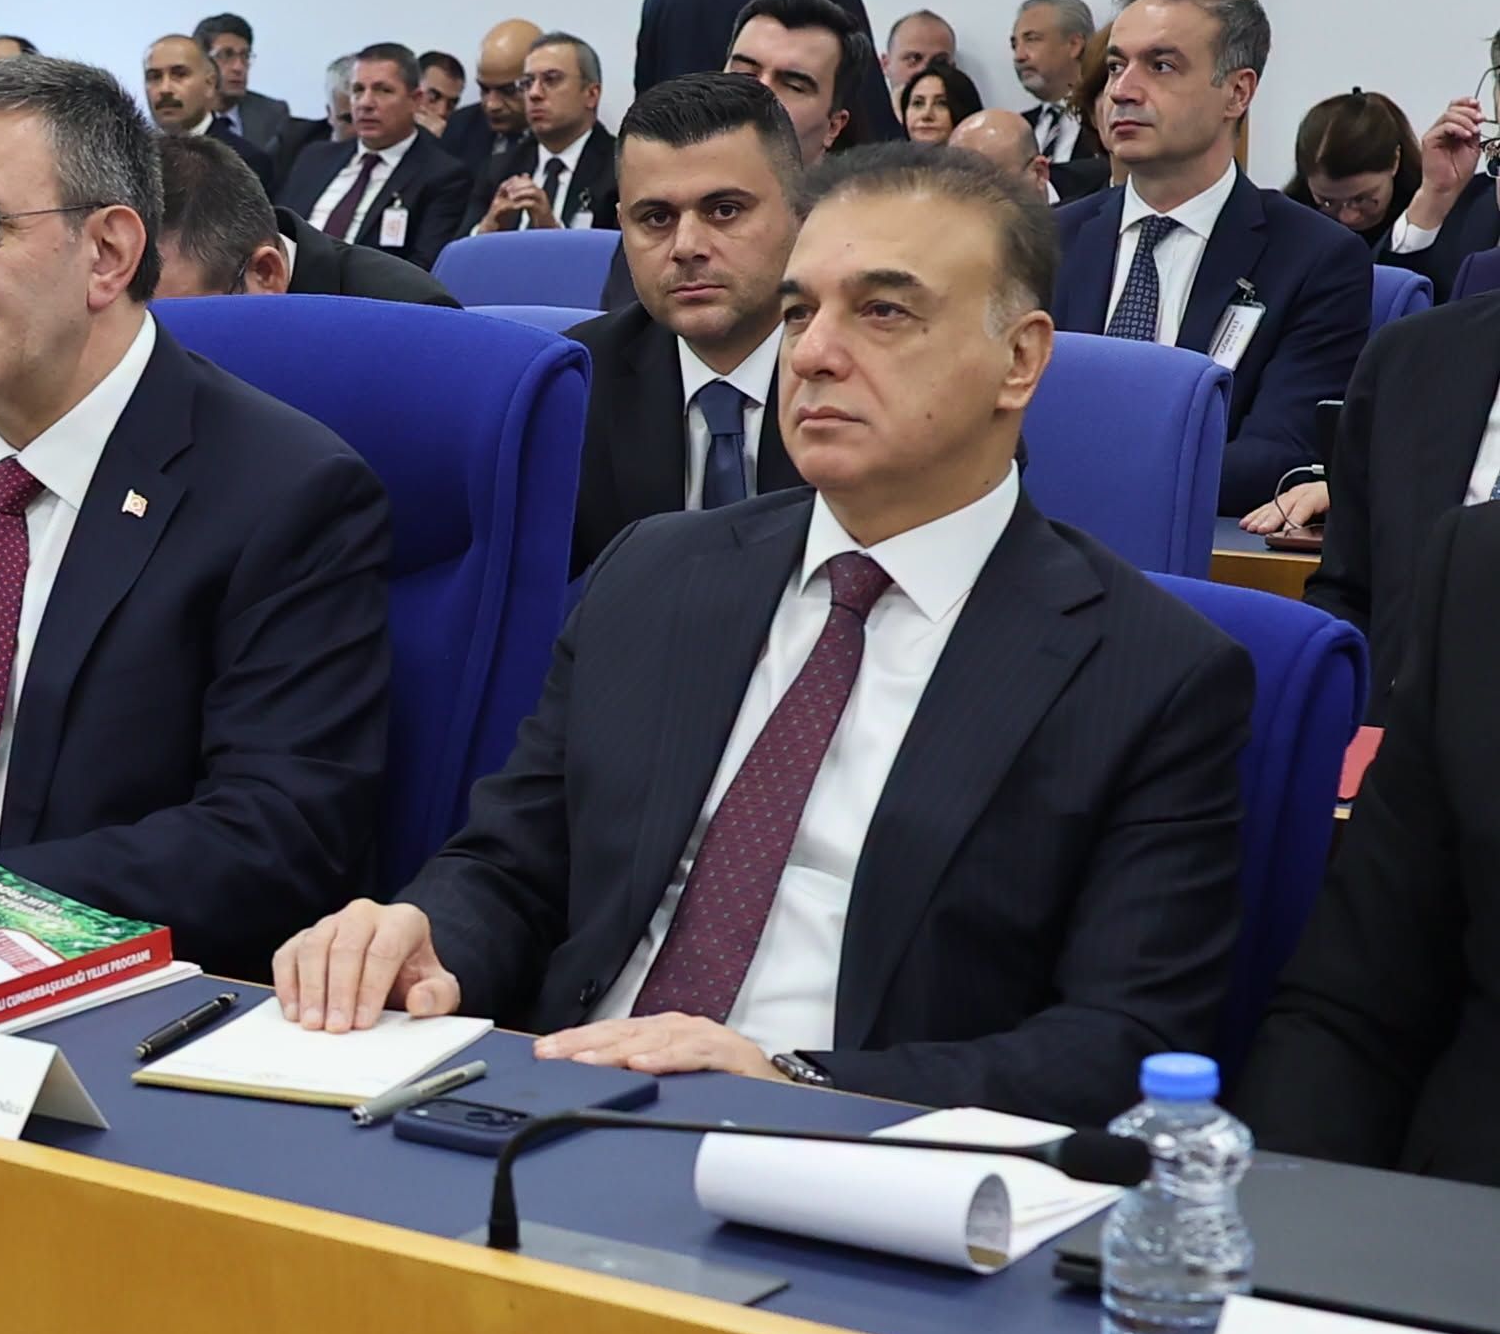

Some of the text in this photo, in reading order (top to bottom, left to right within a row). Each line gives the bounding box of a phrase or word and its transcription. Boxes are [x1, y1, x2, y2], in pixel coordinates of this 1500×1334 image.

[7, 970, 86, 1009] CUMHURBAŞKANLIĞI
[87, 963, 110, 982] YILLIK
[110, 949, 151, 973] PROGRAMI
